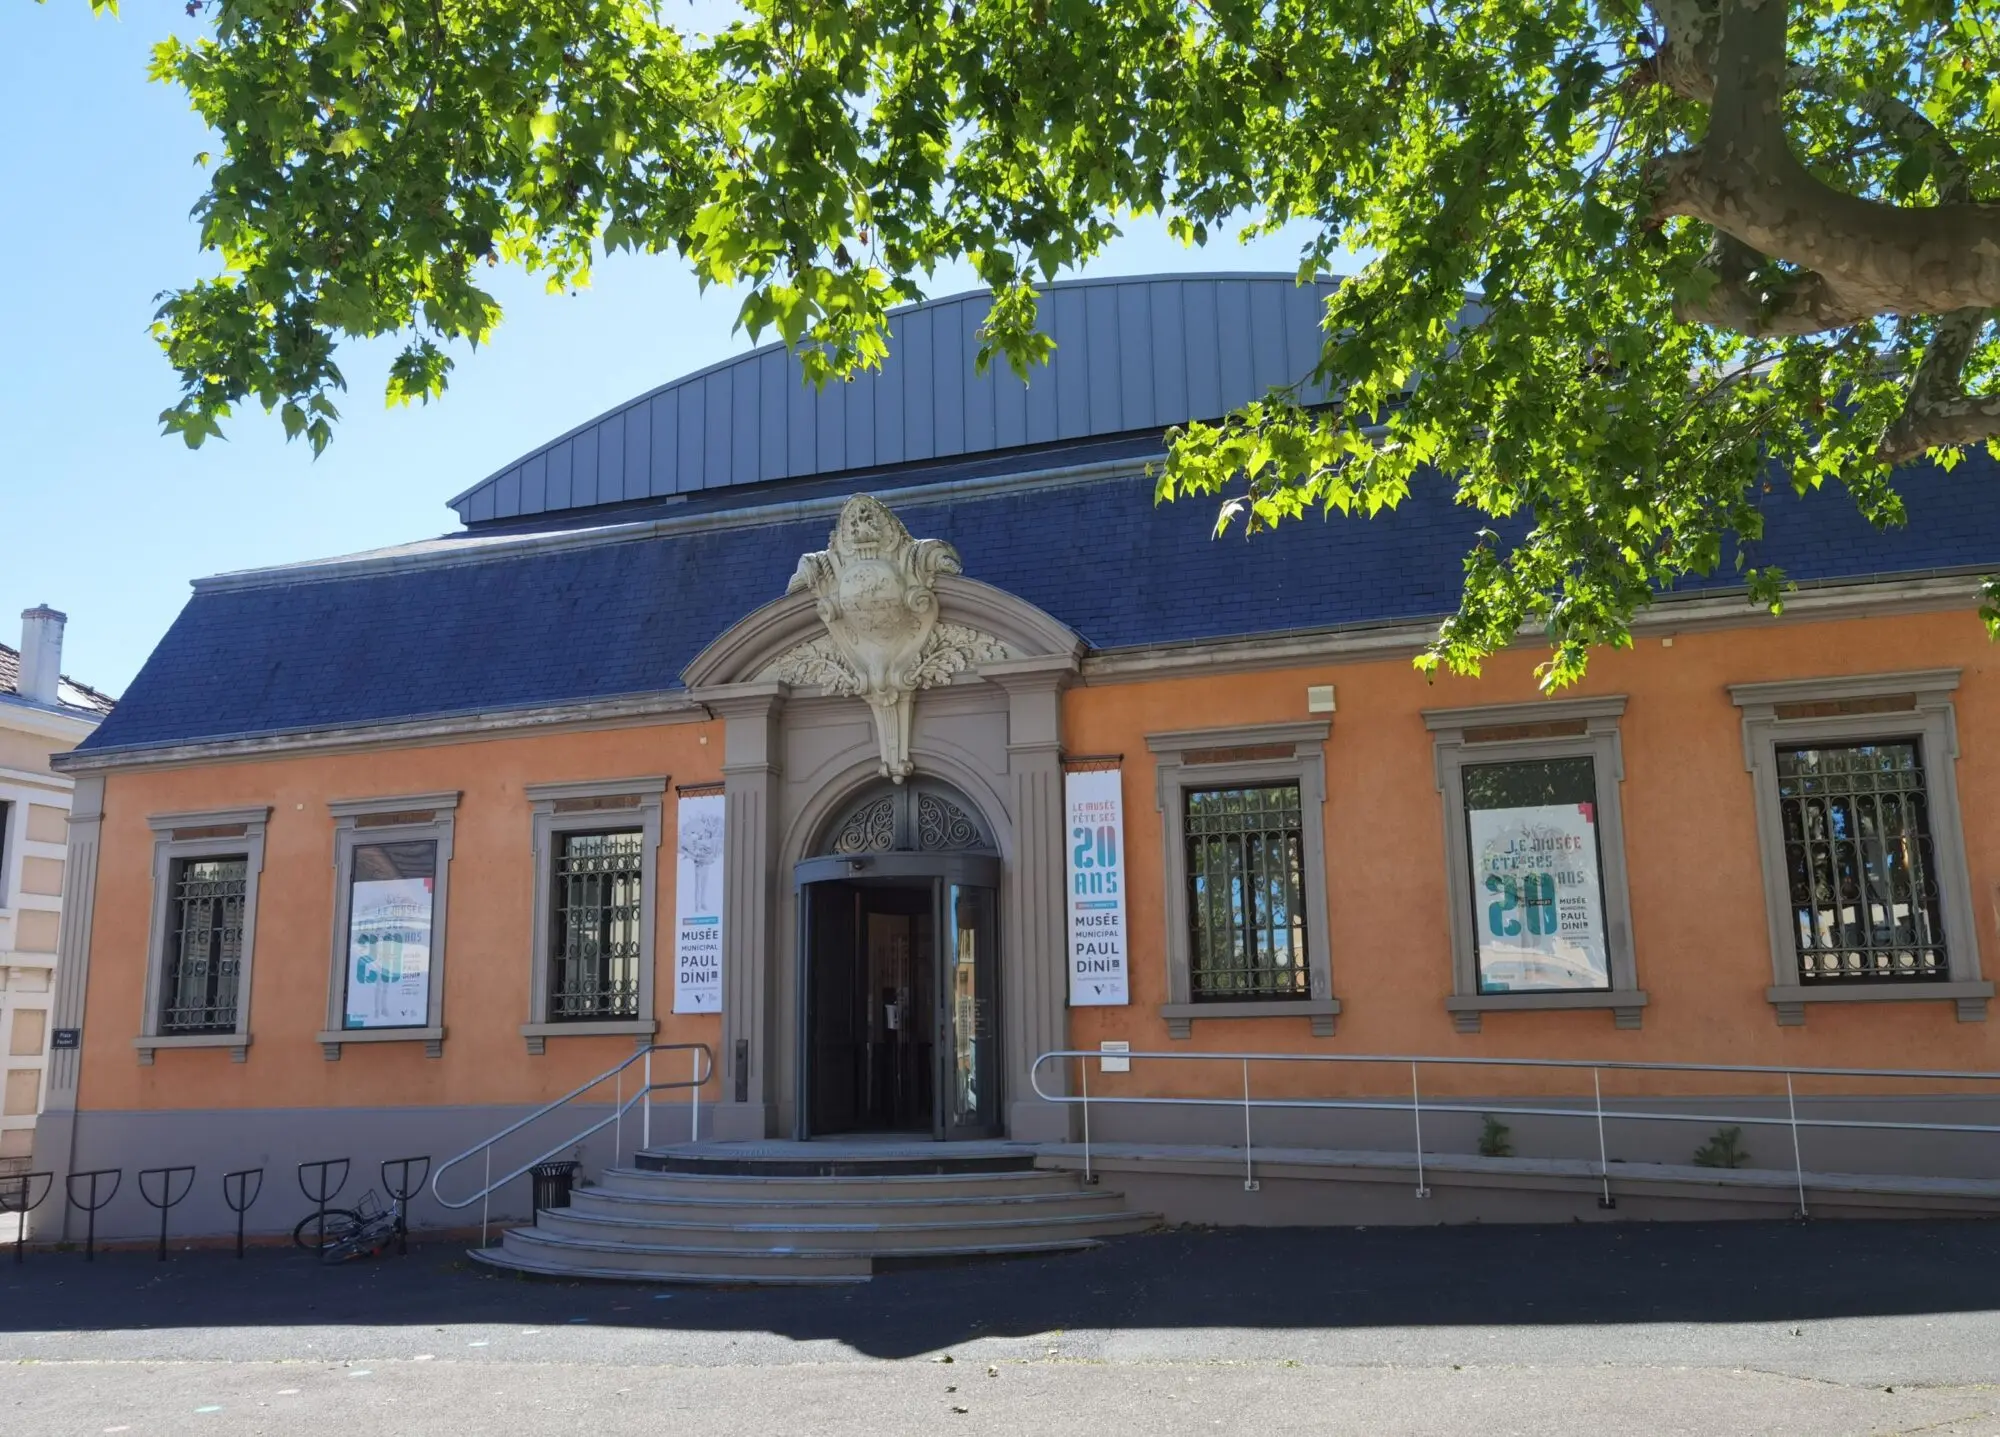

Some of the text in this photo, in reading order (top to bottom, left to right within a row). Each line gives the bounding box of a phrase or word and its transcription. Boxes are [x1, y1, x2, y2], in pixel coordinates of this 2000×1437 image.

[1073, 800, 1116, 812] LE MUSÉE
[1099, 812, 1116, 822] SES
[1073, 825, 1117, 869] 20
[1074, 871, 1118, 895] ANS
[1485, 872, 1558, 937] 20
[1560, 896, 1587, 905] MUSÉE
[1075, 913, 1119, 927] MUSÉE
[1561, 911, 1588, 921] PAUL
[1561, 921, 1583, 930] DINI
[681, 927, 719, 941] MUSÉE
[1075, 930, 1119, 938] MUNICIPAL
[681, 944, 718, 952] MUNICIPAL
[1076, 942, 1120, 956] PAUL
[681, 955, 718, 967] PAUL
[1076, 957, 1110, 973] DINI
[681, 968, 710, 984] DINI
